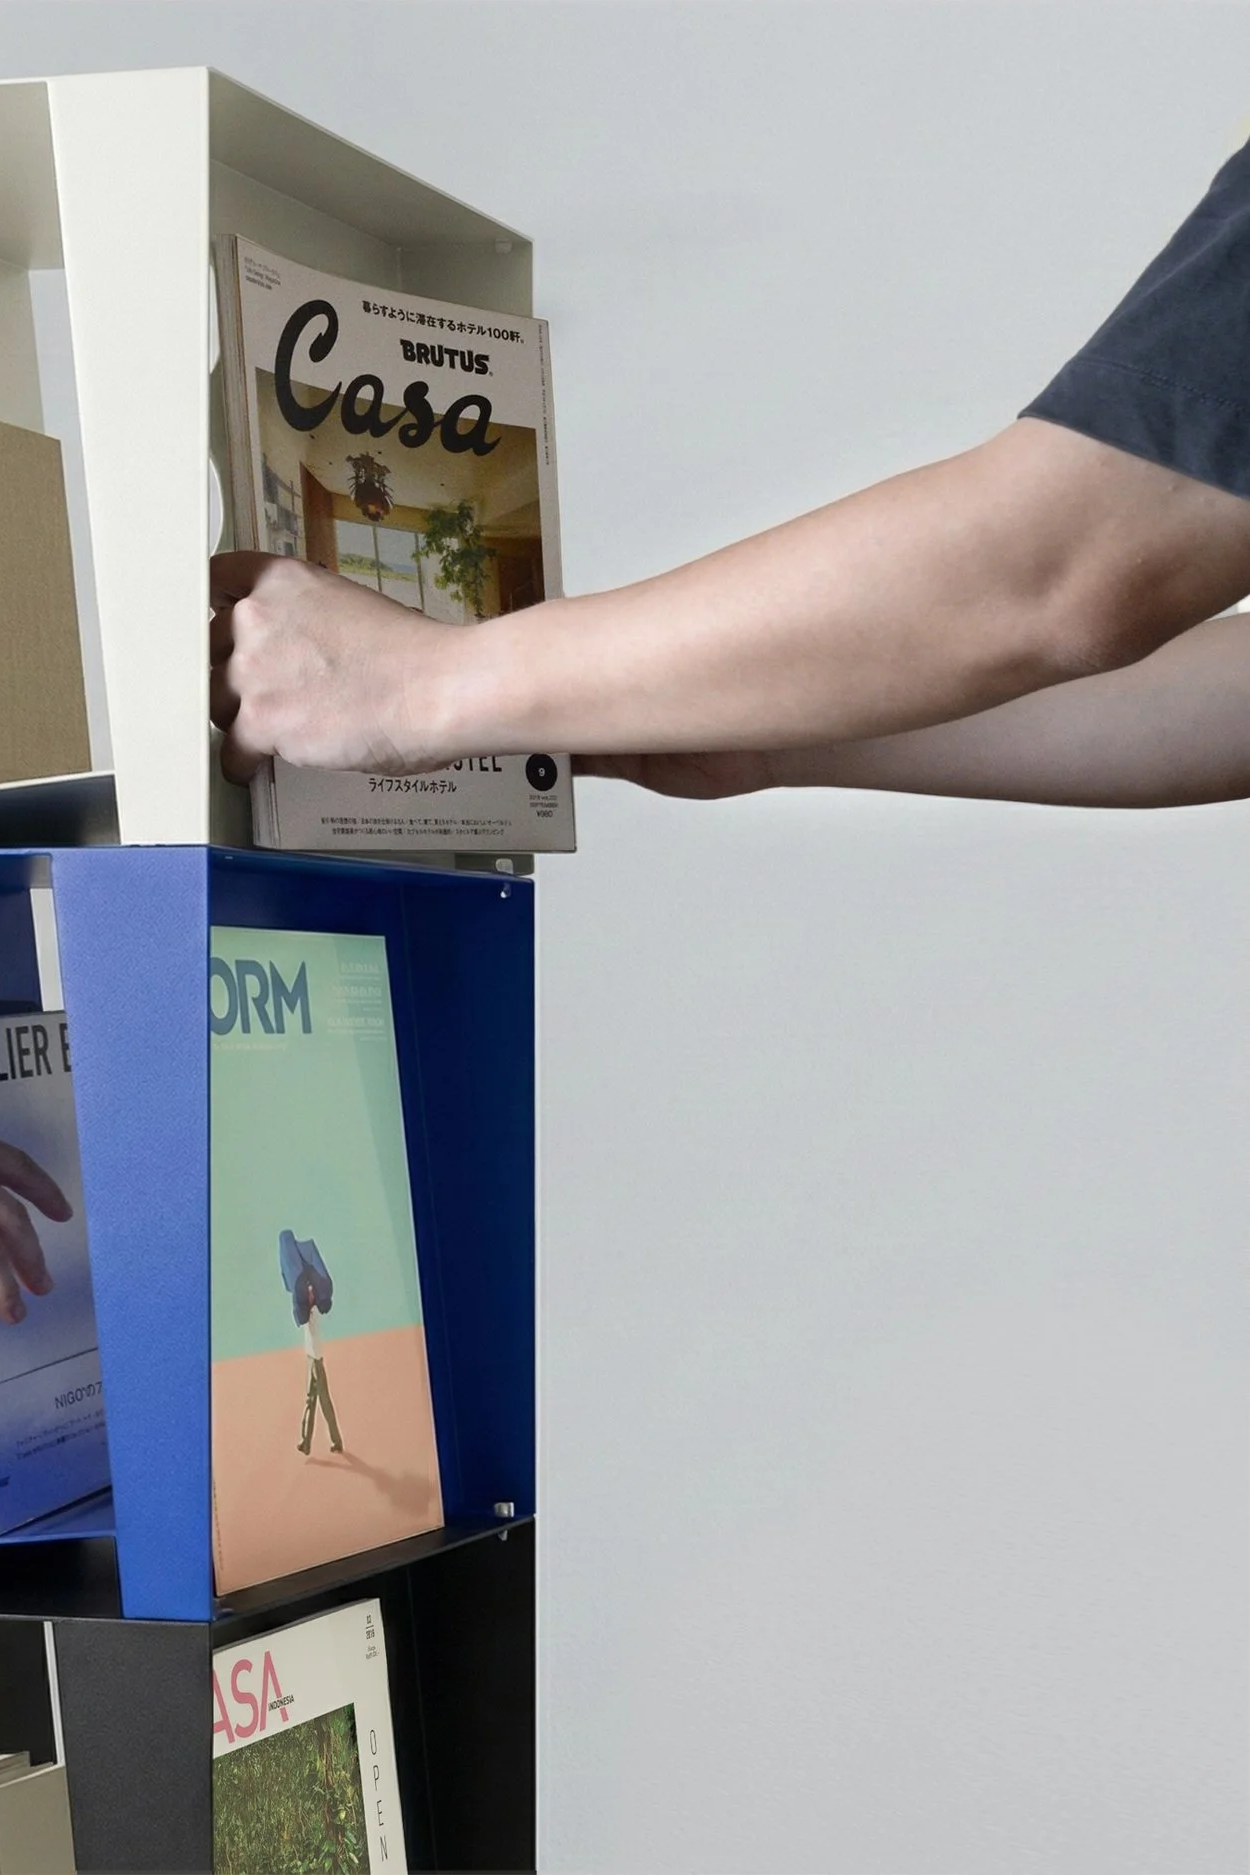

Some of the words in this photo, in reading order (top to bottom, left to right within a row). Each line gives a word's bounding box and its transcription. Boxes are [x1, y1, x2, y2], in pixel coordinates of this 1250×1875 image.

[275, 299, 502, 456] Casa
[369, 778, 457, 794] ライフスタイルホテル
[268, 1694, 295, 1711] INDONESIA
[369, 1729, 388, 1863] OPEN
